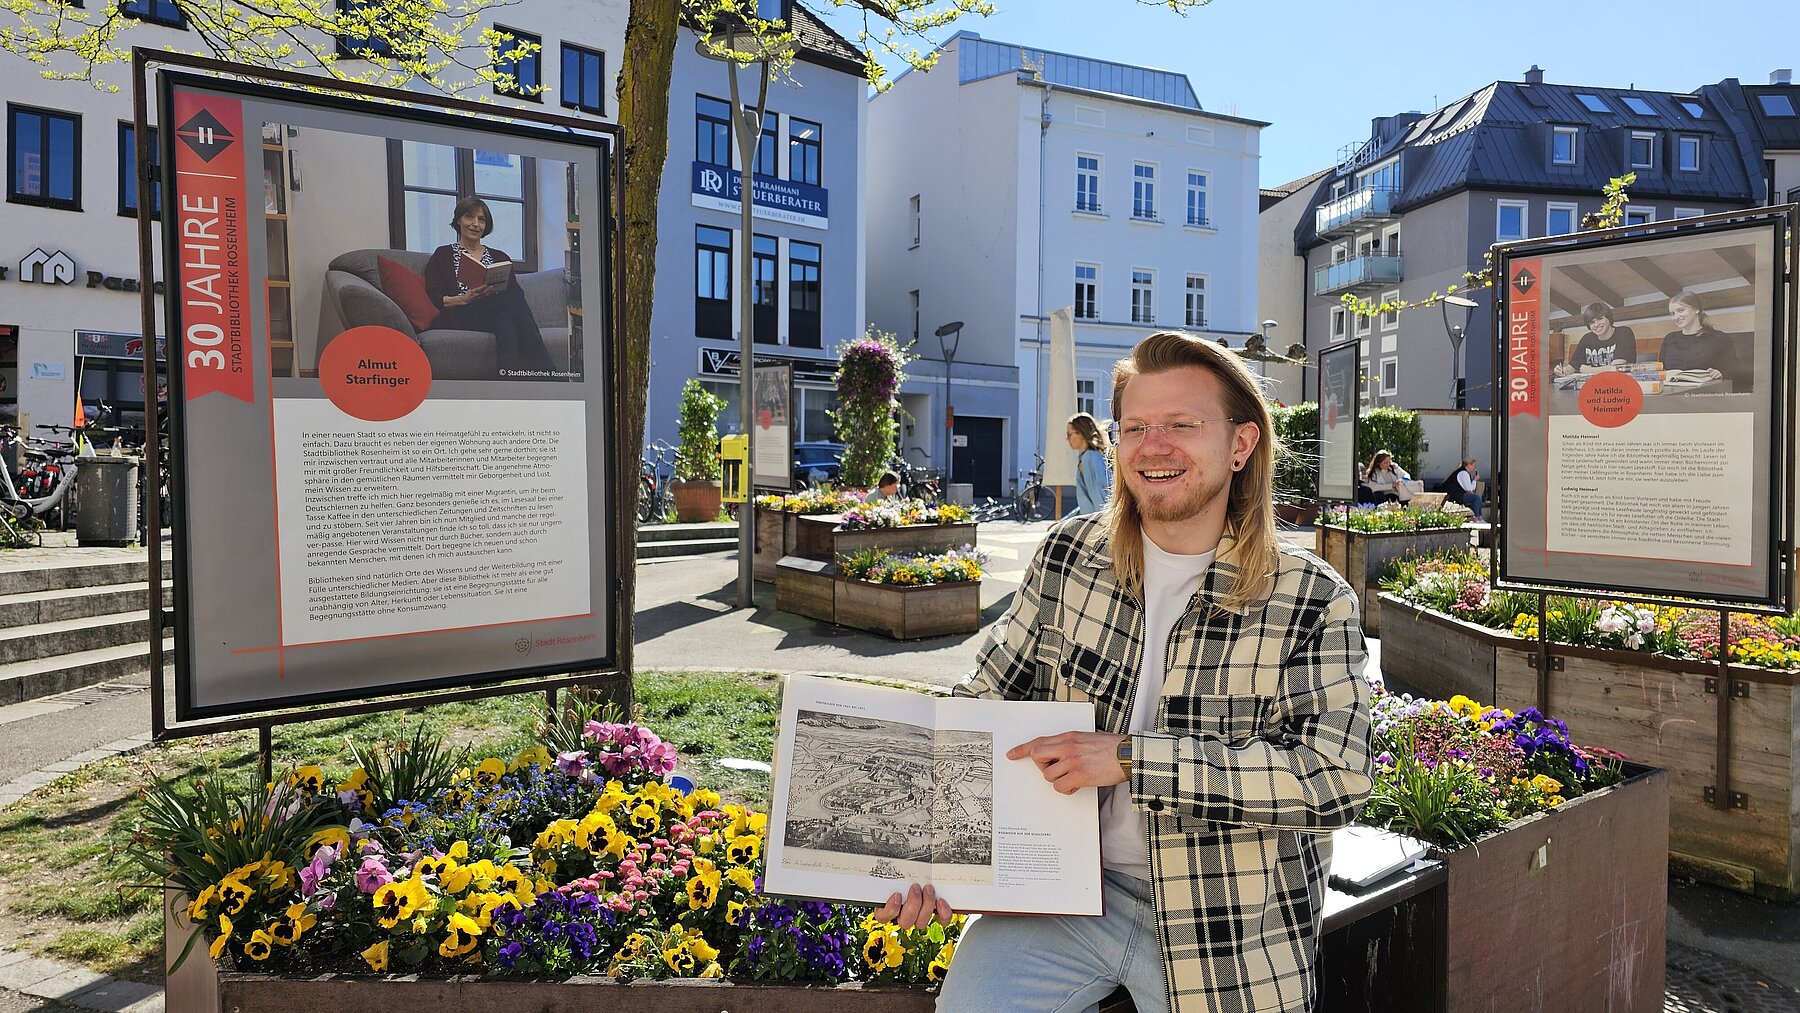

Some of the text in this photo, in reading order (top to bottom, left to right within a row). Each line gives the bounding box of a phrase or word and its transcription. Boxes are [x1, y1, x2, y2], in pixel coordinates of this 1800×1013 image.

[182, 194, 225, 370] 30 JAHRE
[225, 197, 242, 373] STADTBIBLIOTHEK ROSENHEIM
[1511, 311, 1528, 402] 30 JAHRE
[358, 359, 397, 370] Almut
[346, 374, 410, 387] Starfinger
[1603, 396, 1630, 405] Ludwig
[435, 430, 480, 438] Heimatgefühl
[332, 467, 357, 476] großer
[356, 475, 400, 484] gemütlichen
[452, 498, 479, 507] genieße
[308, 575, 354, 584] Bibliotheken
[491, 562, 535, 570] Weiterbildung
[536, 633, 596, 647] Stadt Rosenheim
